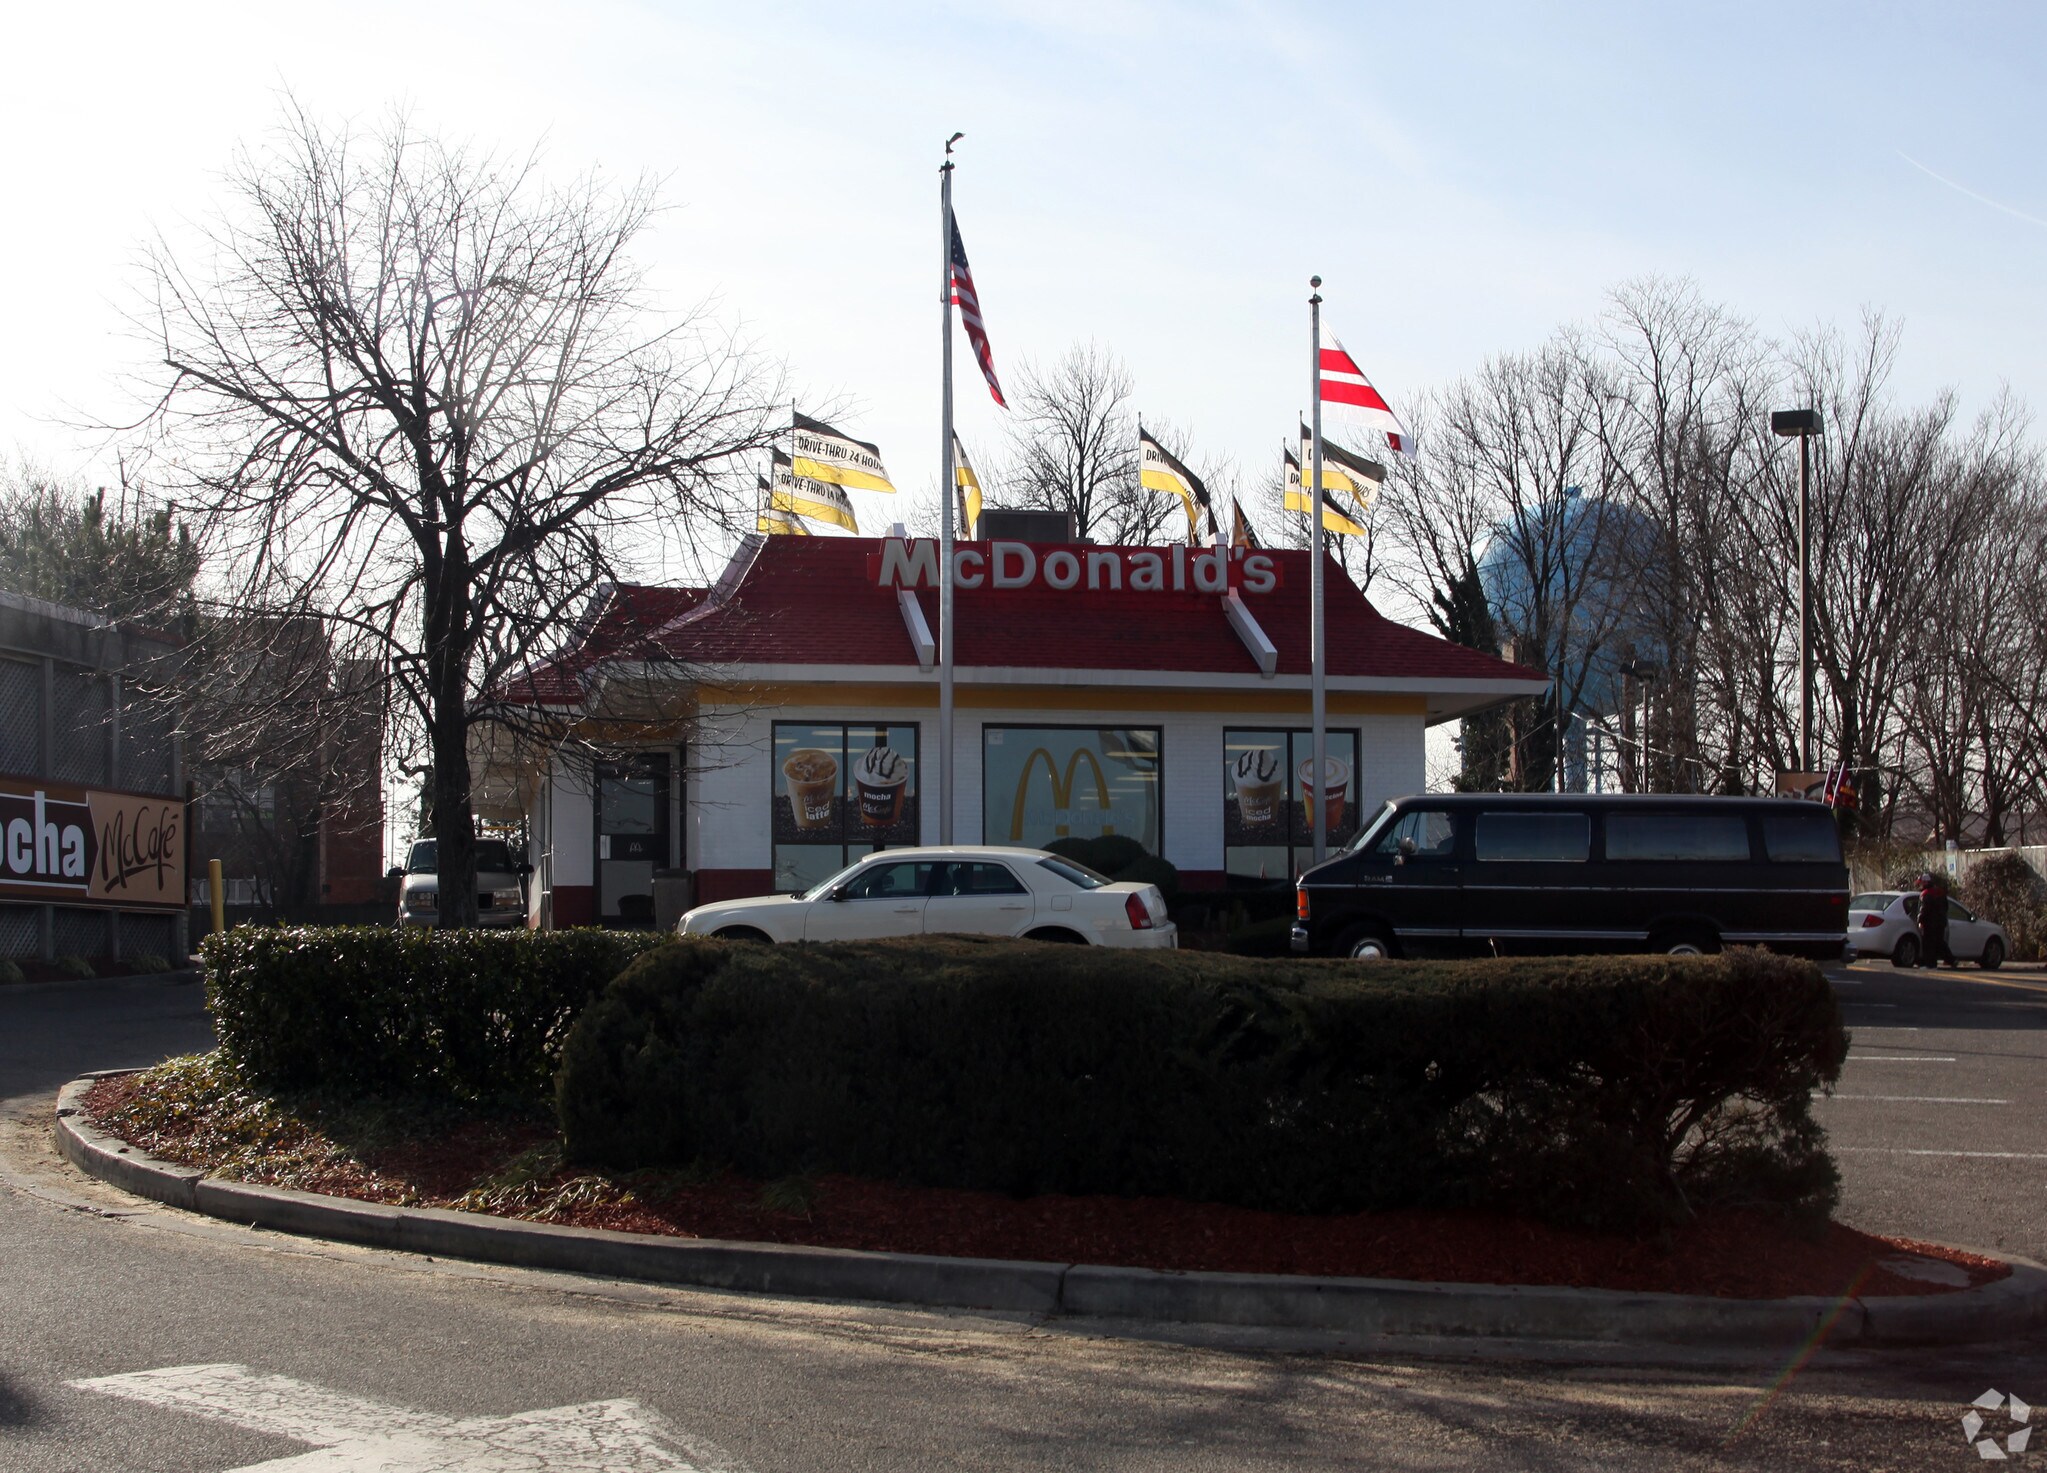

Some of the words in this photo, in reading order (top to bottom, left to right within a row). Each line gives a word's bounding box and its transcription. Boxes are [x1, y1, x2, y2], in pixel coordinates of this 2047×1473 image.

[798, 436, 848, 459] DRIVE-THRU
[849, 450, 860, 463] 24
[781, 473, 826, 497] DRIVE-THRU
[877, 537, 1279, 595] McDonald's
[863, 791, 892, 801] mocha
[804, 800, 830, 813] iced
[805, 809, 830, 821] latte
[1245, 805, 1271, 816] iced
[1246, 814, 1272, 822] mocha
[0, 790, 85, 878] cha
[101, 805, 179, 893] McCafé
